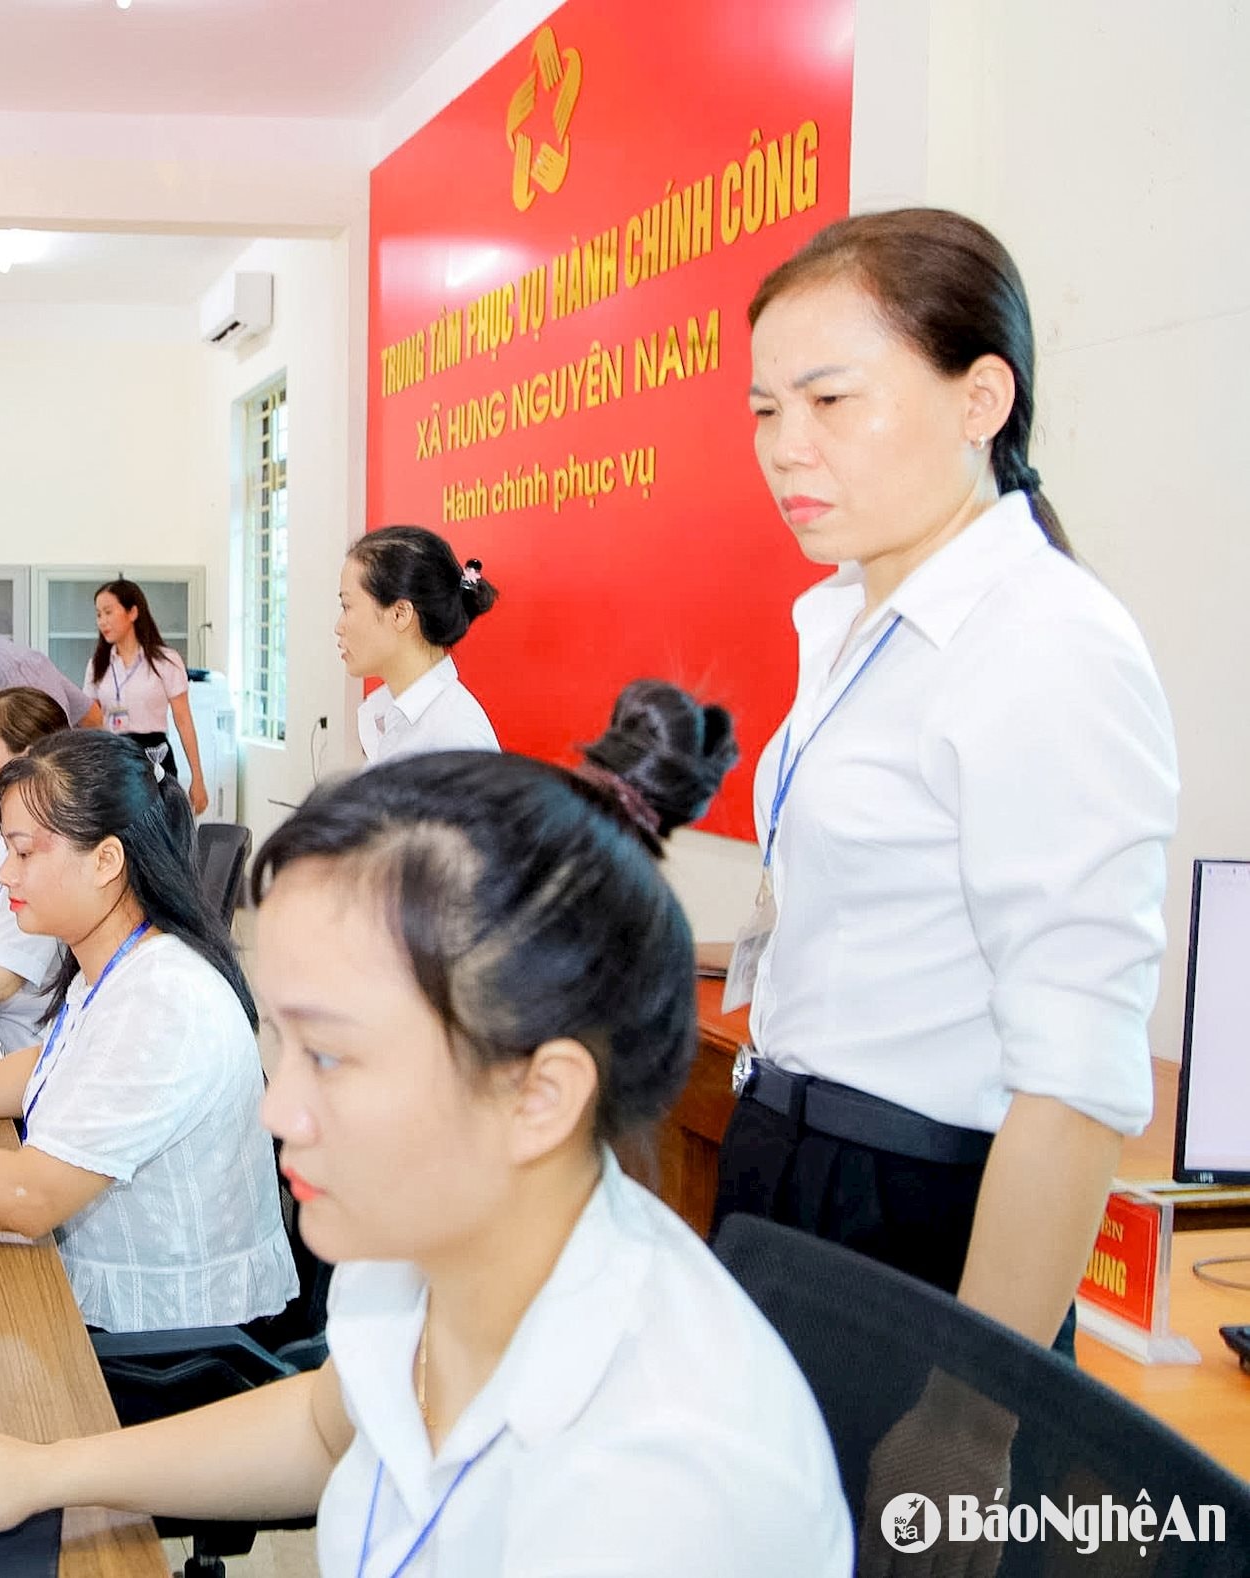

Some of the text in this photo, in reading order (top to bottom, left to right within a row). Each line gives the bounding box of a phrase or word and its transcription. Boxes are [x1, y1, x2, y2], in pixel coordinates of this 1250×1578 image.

[381, 119, 819, 397] TRUNG TÂM PHỤC VỤ HÀNH CHÍNH CÔNG
[416, 402, 443, 461] XÃ
[511, 340, 623, 431] NGUYÊN
[634, 308, 720, 393] NAM
[442, 446, 656, 524] Hành chính phục vụ
